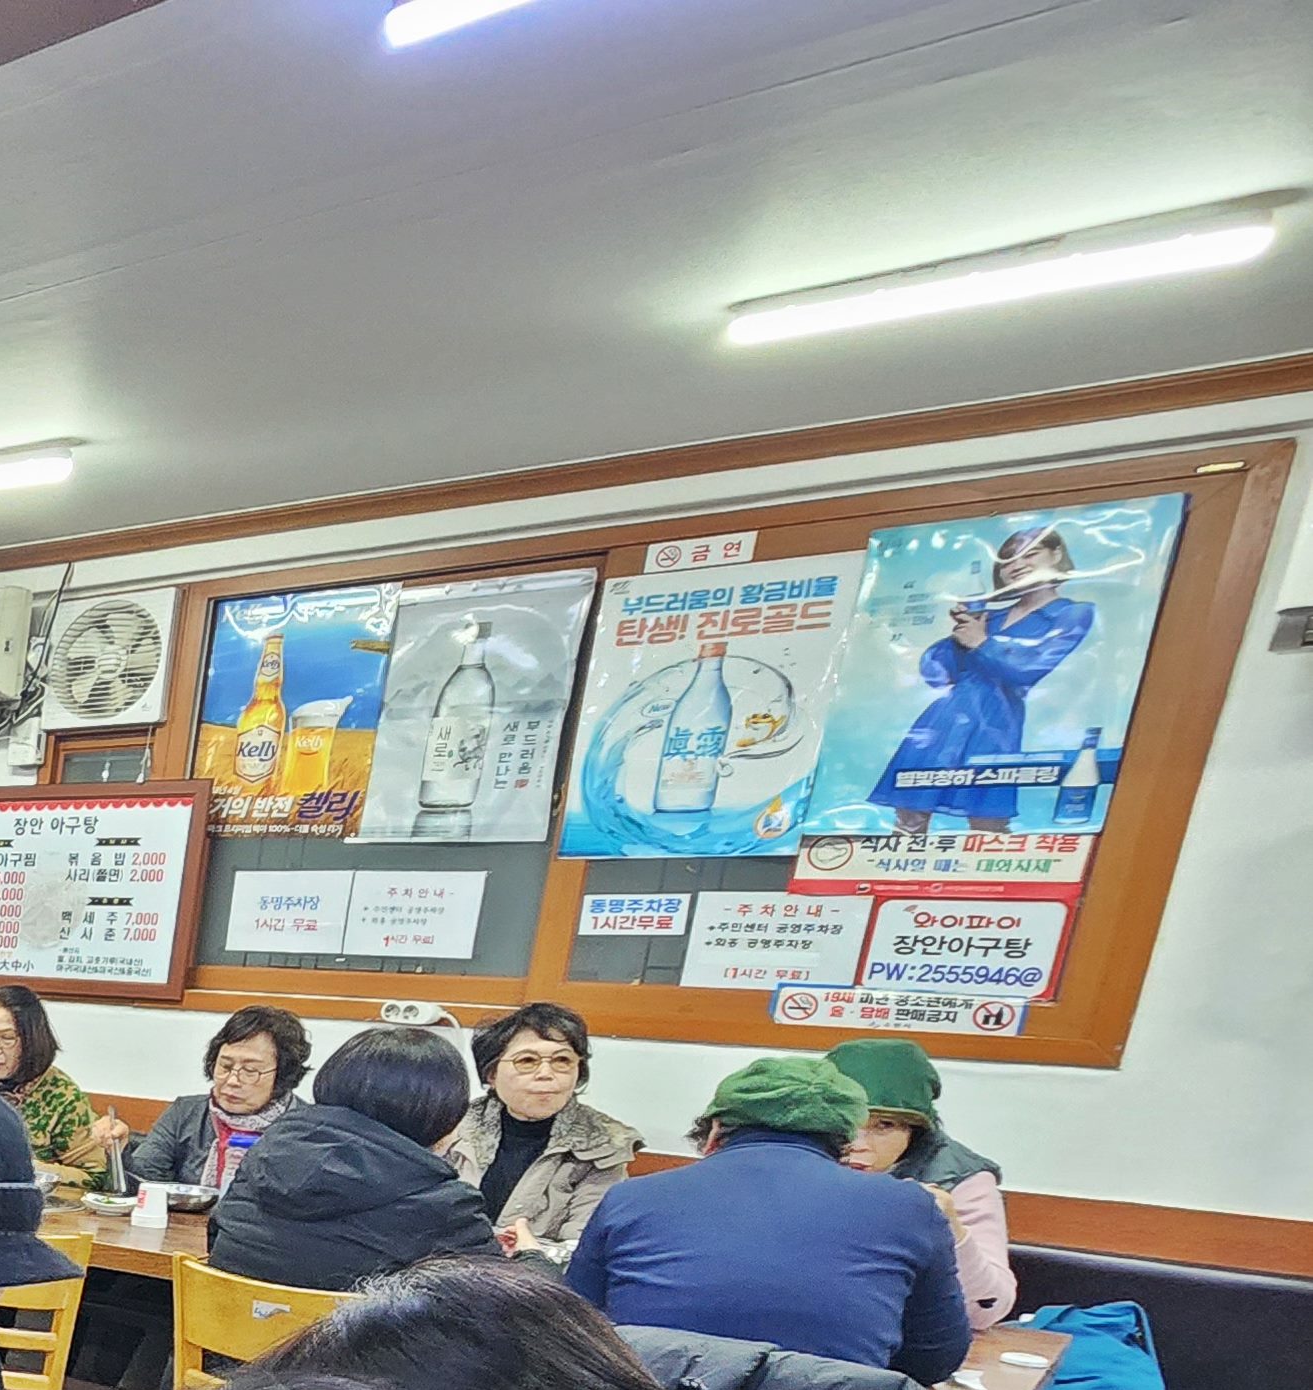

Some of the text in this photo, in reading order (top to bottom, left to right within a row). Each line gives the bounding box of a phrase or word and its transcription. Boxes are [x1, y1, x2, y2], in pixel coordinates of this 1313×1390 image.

[621, 586, 734, 615] 부드러움의
[739, 575, 840, 604] 황금비율
[614, 600, 834, 647] 탄생! 진로골드
[294, 735, 324, 750] Kelly
[433, 725, 452, 758] 새로
[237, 740, 279, 762] Kelly
[974, 766, 1060, 785] 스파클링
[209, 788, 361, 822] 거의 반전 켈리
[13, 816, 99, 836] 장안 아구탕
[962, 835, 1028, 852] 마스크
[1036, 835, 1080, 852] 착용
[258, 895, 320, 911] 동명주차장
[589, 898, 683, 914] 동명주차장
[254, 919, 318, 931] 1시간 무료
[591, 915, 674, 930] 1시간무료
[717, 922, 844, 935] 주민센터 공영주차장
[913, 911, 1021, 929] 와이파이
[892, 934, 1033, 959] 장안아구탕
[867, 962, 1043, 987] PW:2555946@
[894, 1008, 958, 1023] 판매금지
